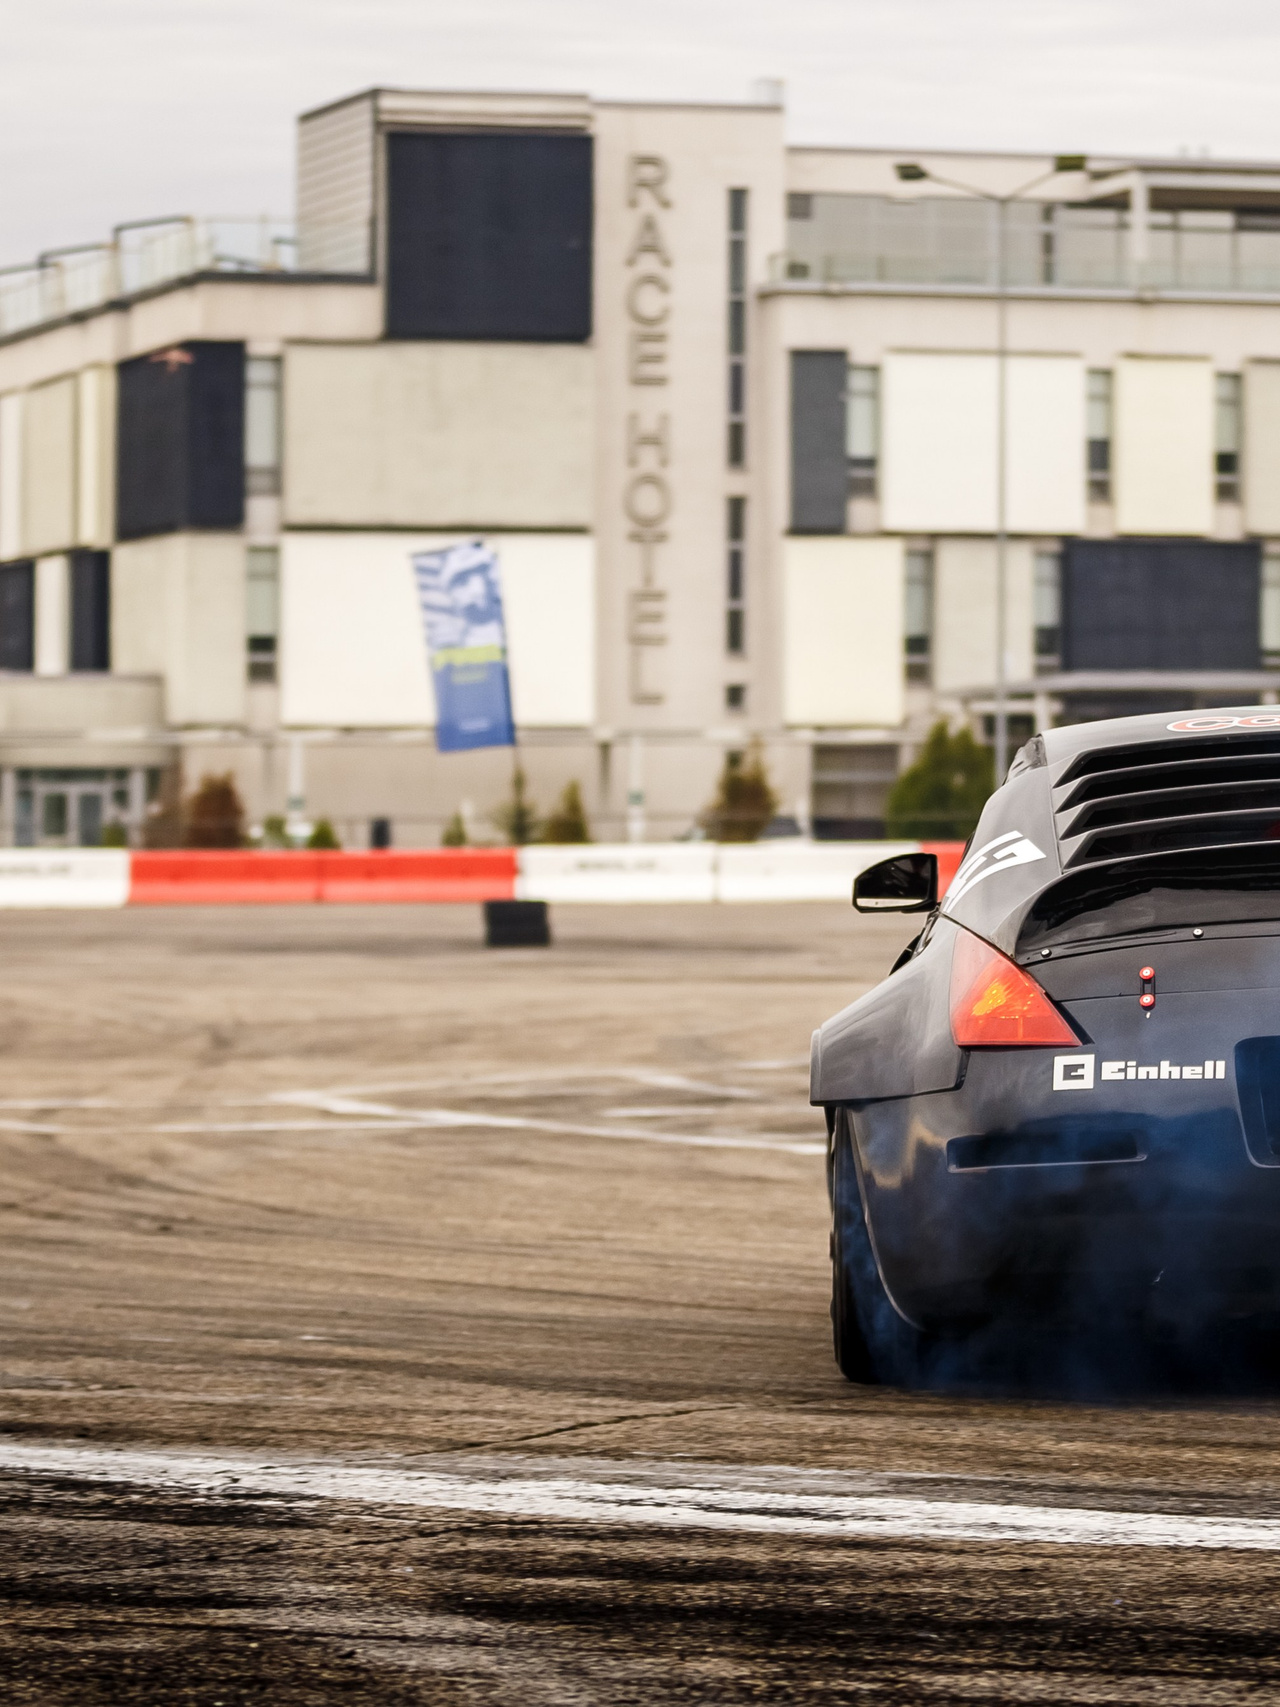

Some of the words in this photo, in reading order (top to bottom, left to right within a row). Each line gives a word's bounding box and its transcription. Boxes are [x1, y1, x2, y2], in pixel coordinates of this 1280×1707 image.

[626, 156, 673, 387] RACE
[622, 411, 672, 706] HOTEL
[1101, 1060, 1226, 1081] Einhell
